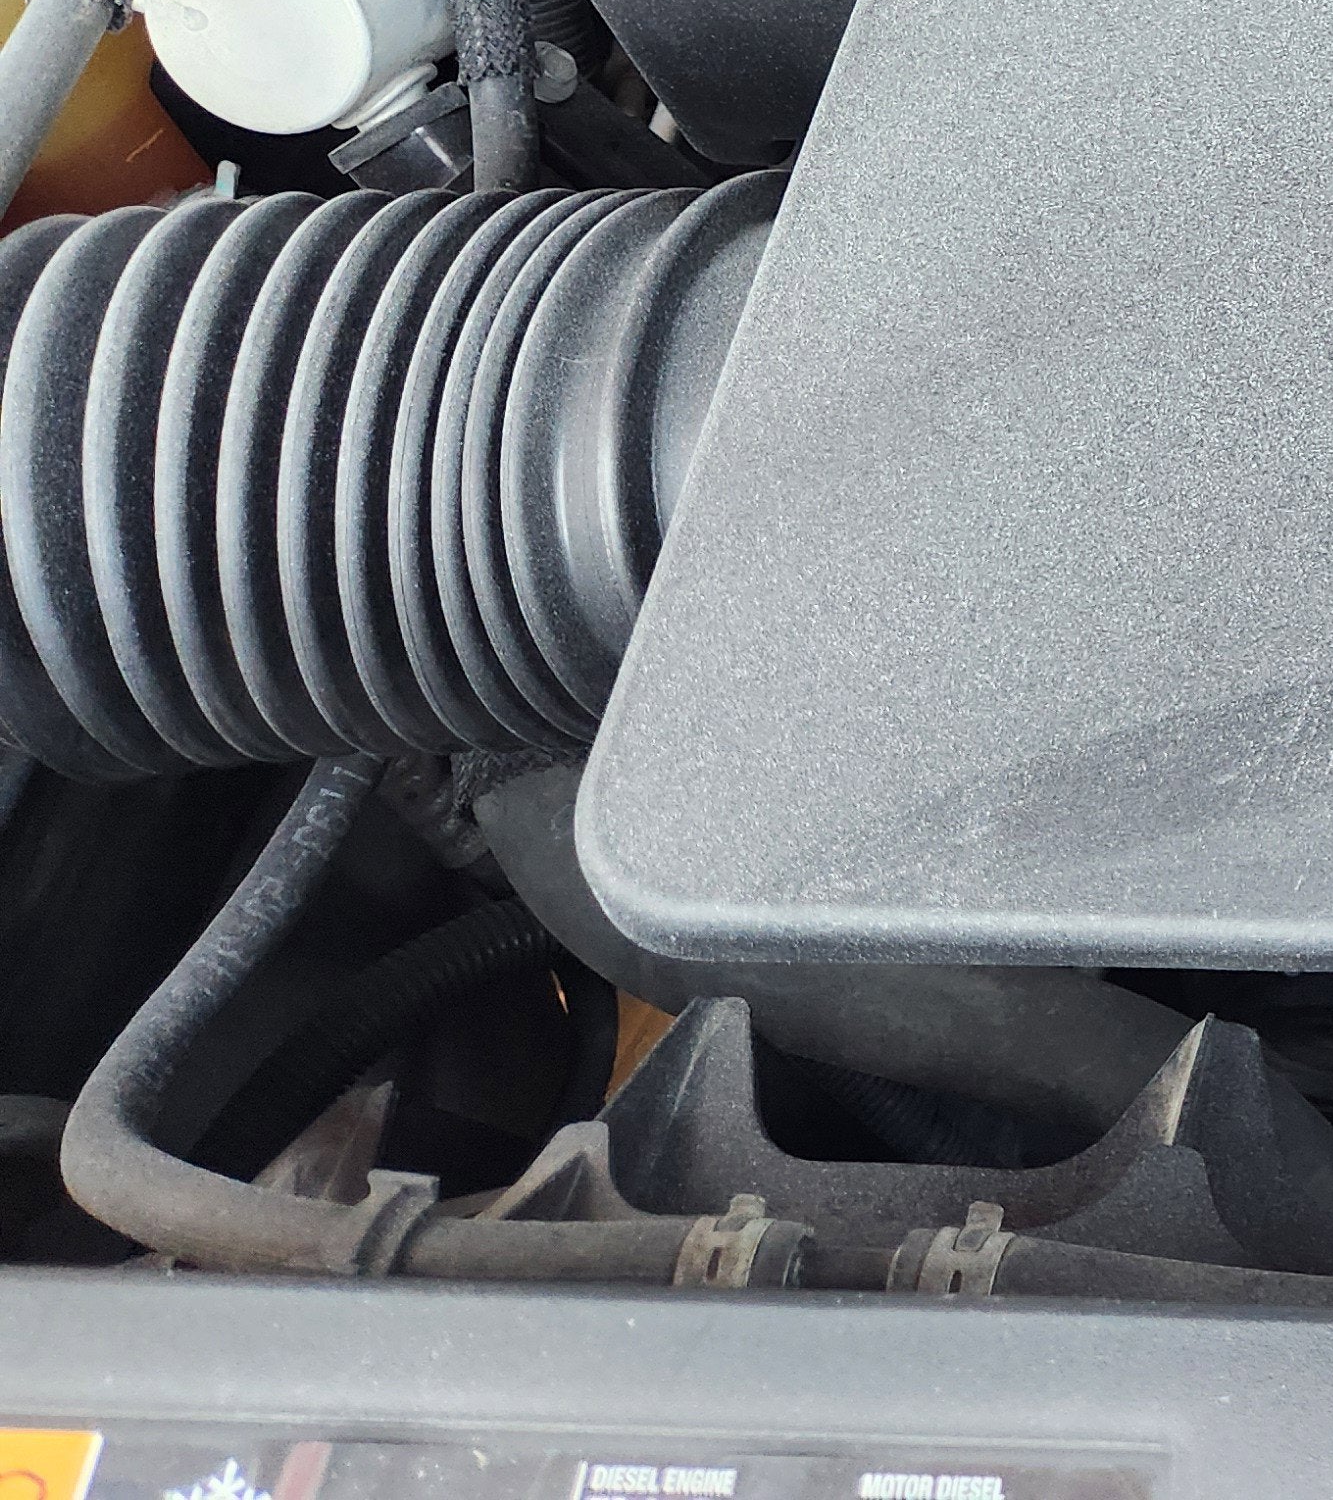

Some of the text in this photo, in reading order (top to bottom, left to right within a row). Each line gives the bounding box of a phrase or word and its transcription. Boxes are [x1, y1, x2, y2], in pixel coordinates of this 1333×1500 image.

[590, 1464, 738, 1496] DIESEL ENGINE
[859, 1472, 1005, 1500] MOTOR DIESEL
